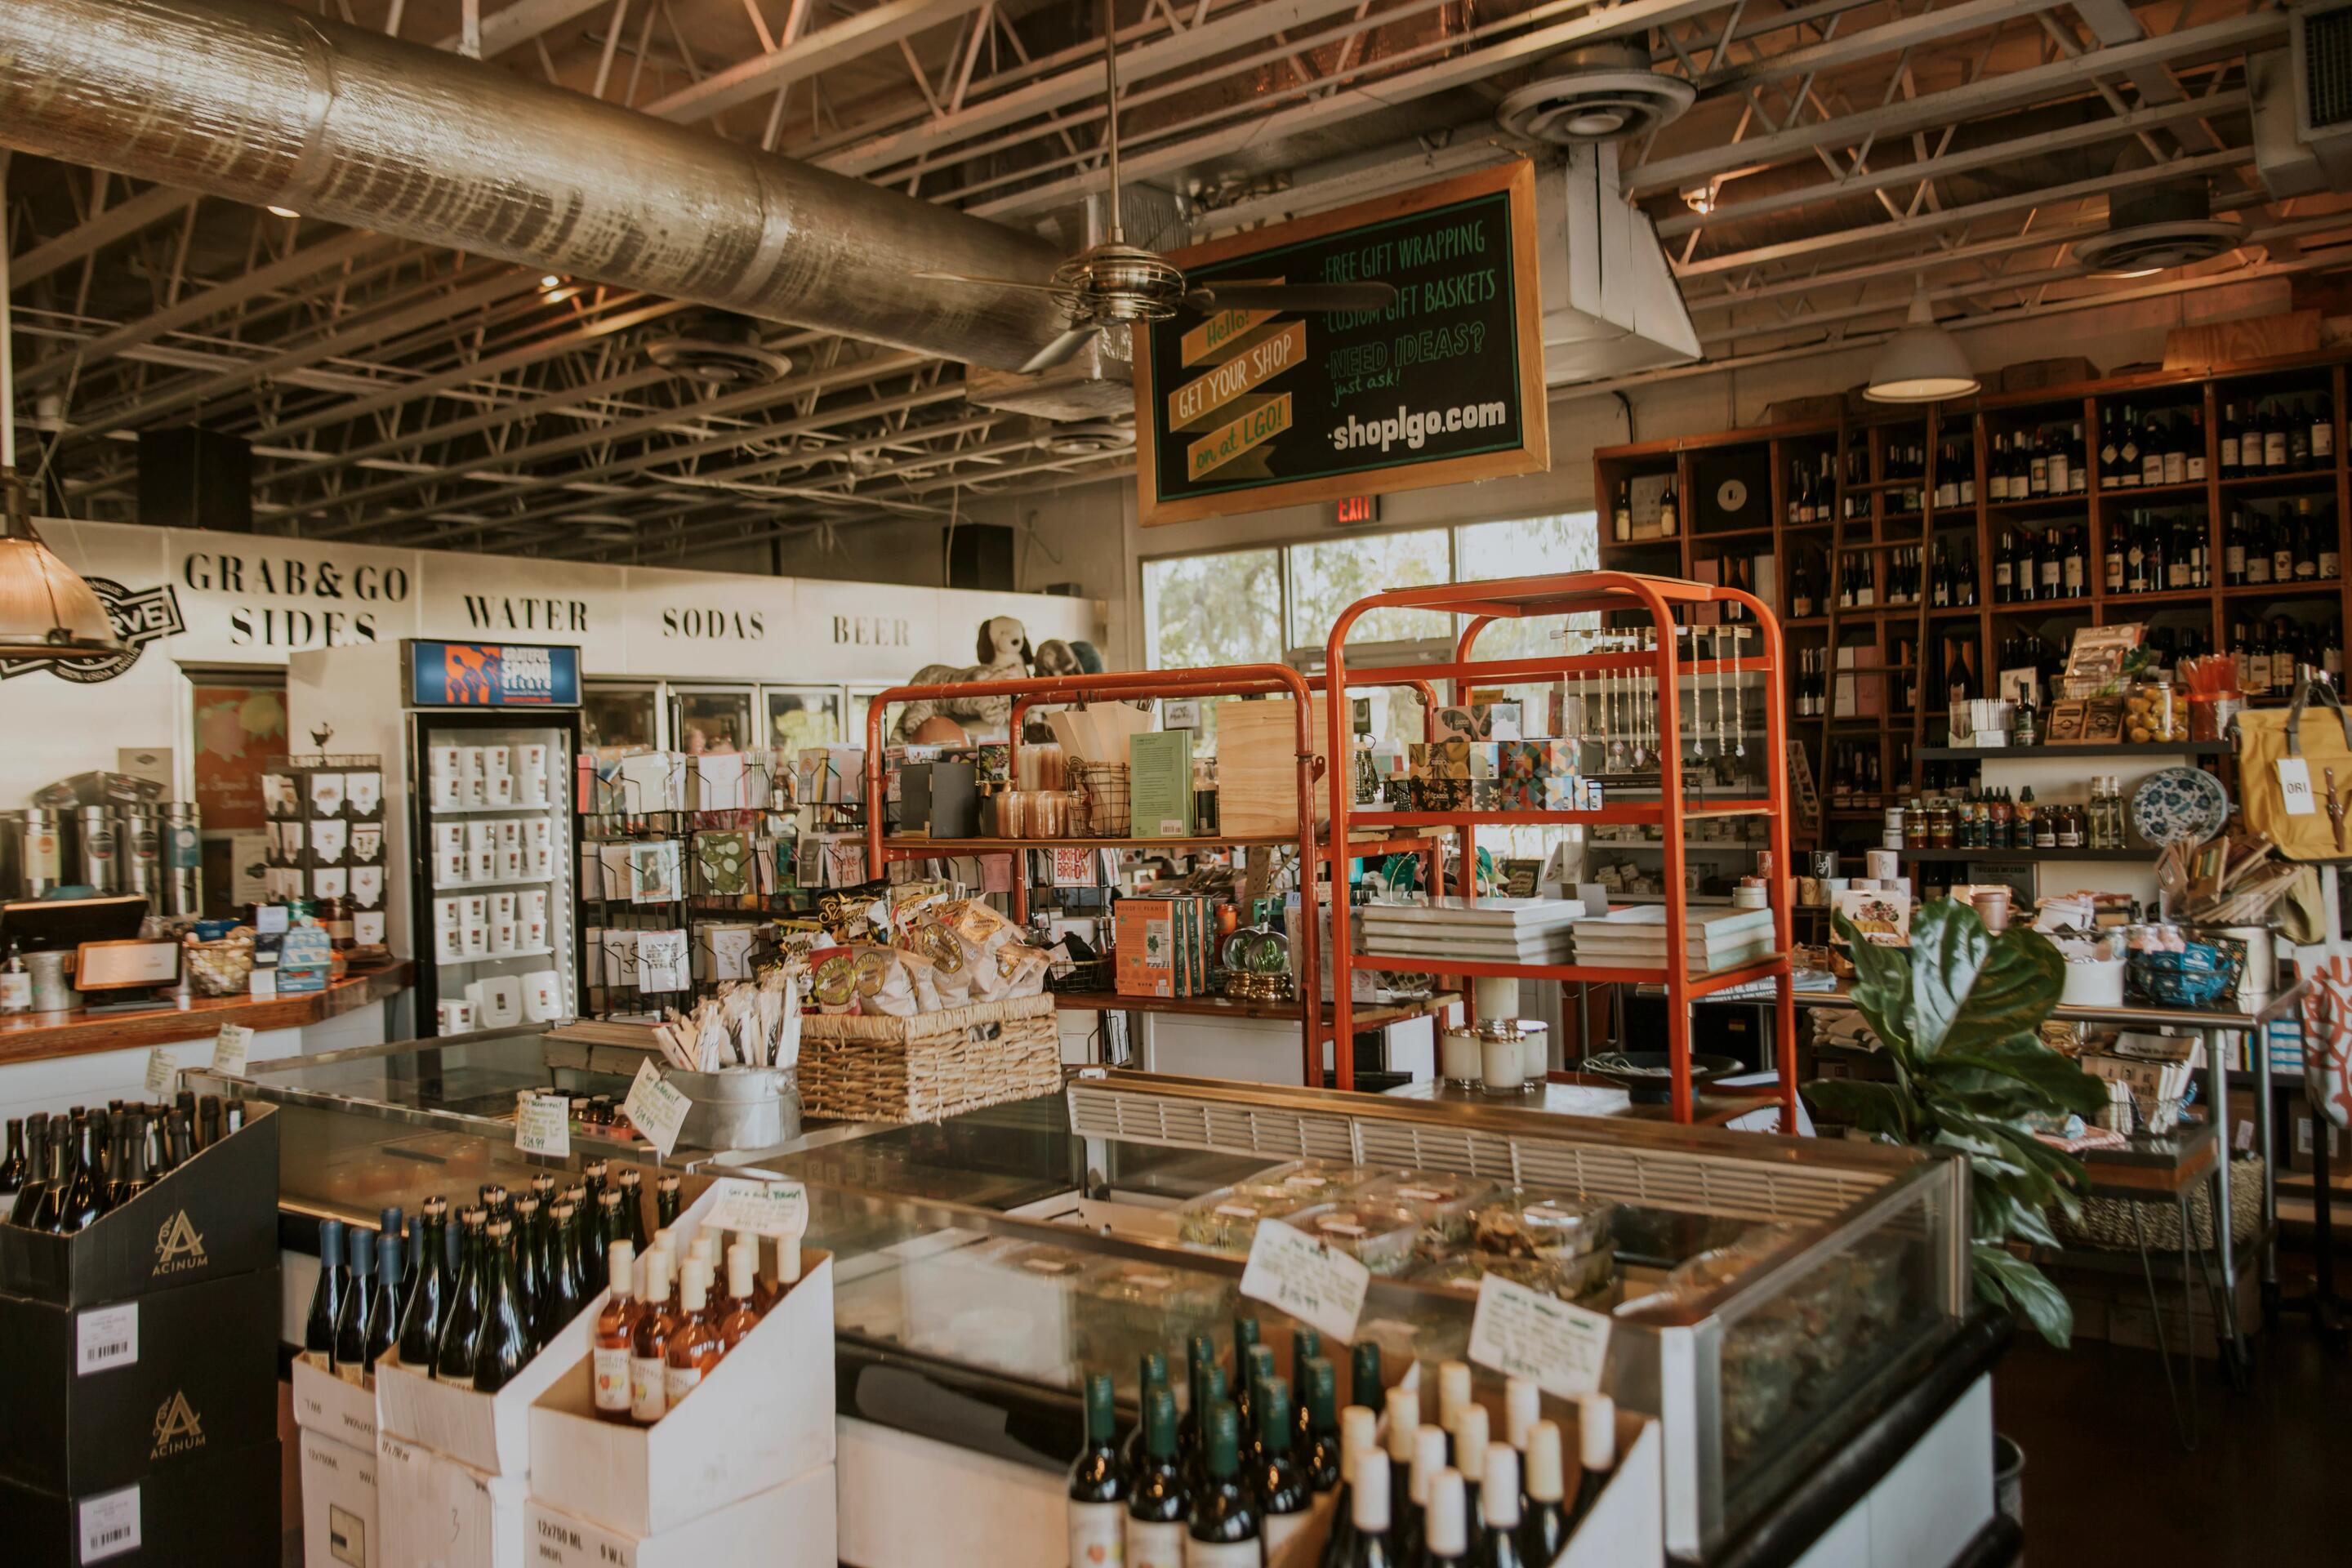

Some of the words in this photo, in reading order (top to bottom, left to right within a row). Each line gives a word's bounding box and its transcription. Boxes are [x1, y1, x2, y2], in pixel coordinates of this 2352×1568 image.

[1325, 252, 1356, 285] FREE
[1361, 243, 1393, 278] GIFT
[1398, 220, 1486, 270] WRAPPING
[1424, 269, 1495, 314] BASKETS
[1206, 309, 1249, 348] Hello!
[1330, 341, 1388, 379] NEED
[1395, 320, 1485, 367] IDEAS?
[1178, 382, 1203, 418] GET
[1208, 360, 1247, 403] YOUR
[1253, 334, 1292, 379] SHOP
[1331, 374, 1363, 408] just
[1367, 368, 1401, 389] ask!
[1196, 449, 1216, 469] on
[1219, 425, 1239, 457] at
[1244, 401, 1282, 445] LGO!
[1334, 401, 1506, 452] shoplgo.com
[231, 607, 378, 648] SIDES
[464, 595, 587, 632] WATER
[662, 608, 764, 640] SODAS
[833, 615, 910, 647] BEER
[501, 662, 551, 679] SPOON
[152, 1255, 208, 1277] ACINUM
[150, 1433, 206, 1461] ACINUM
